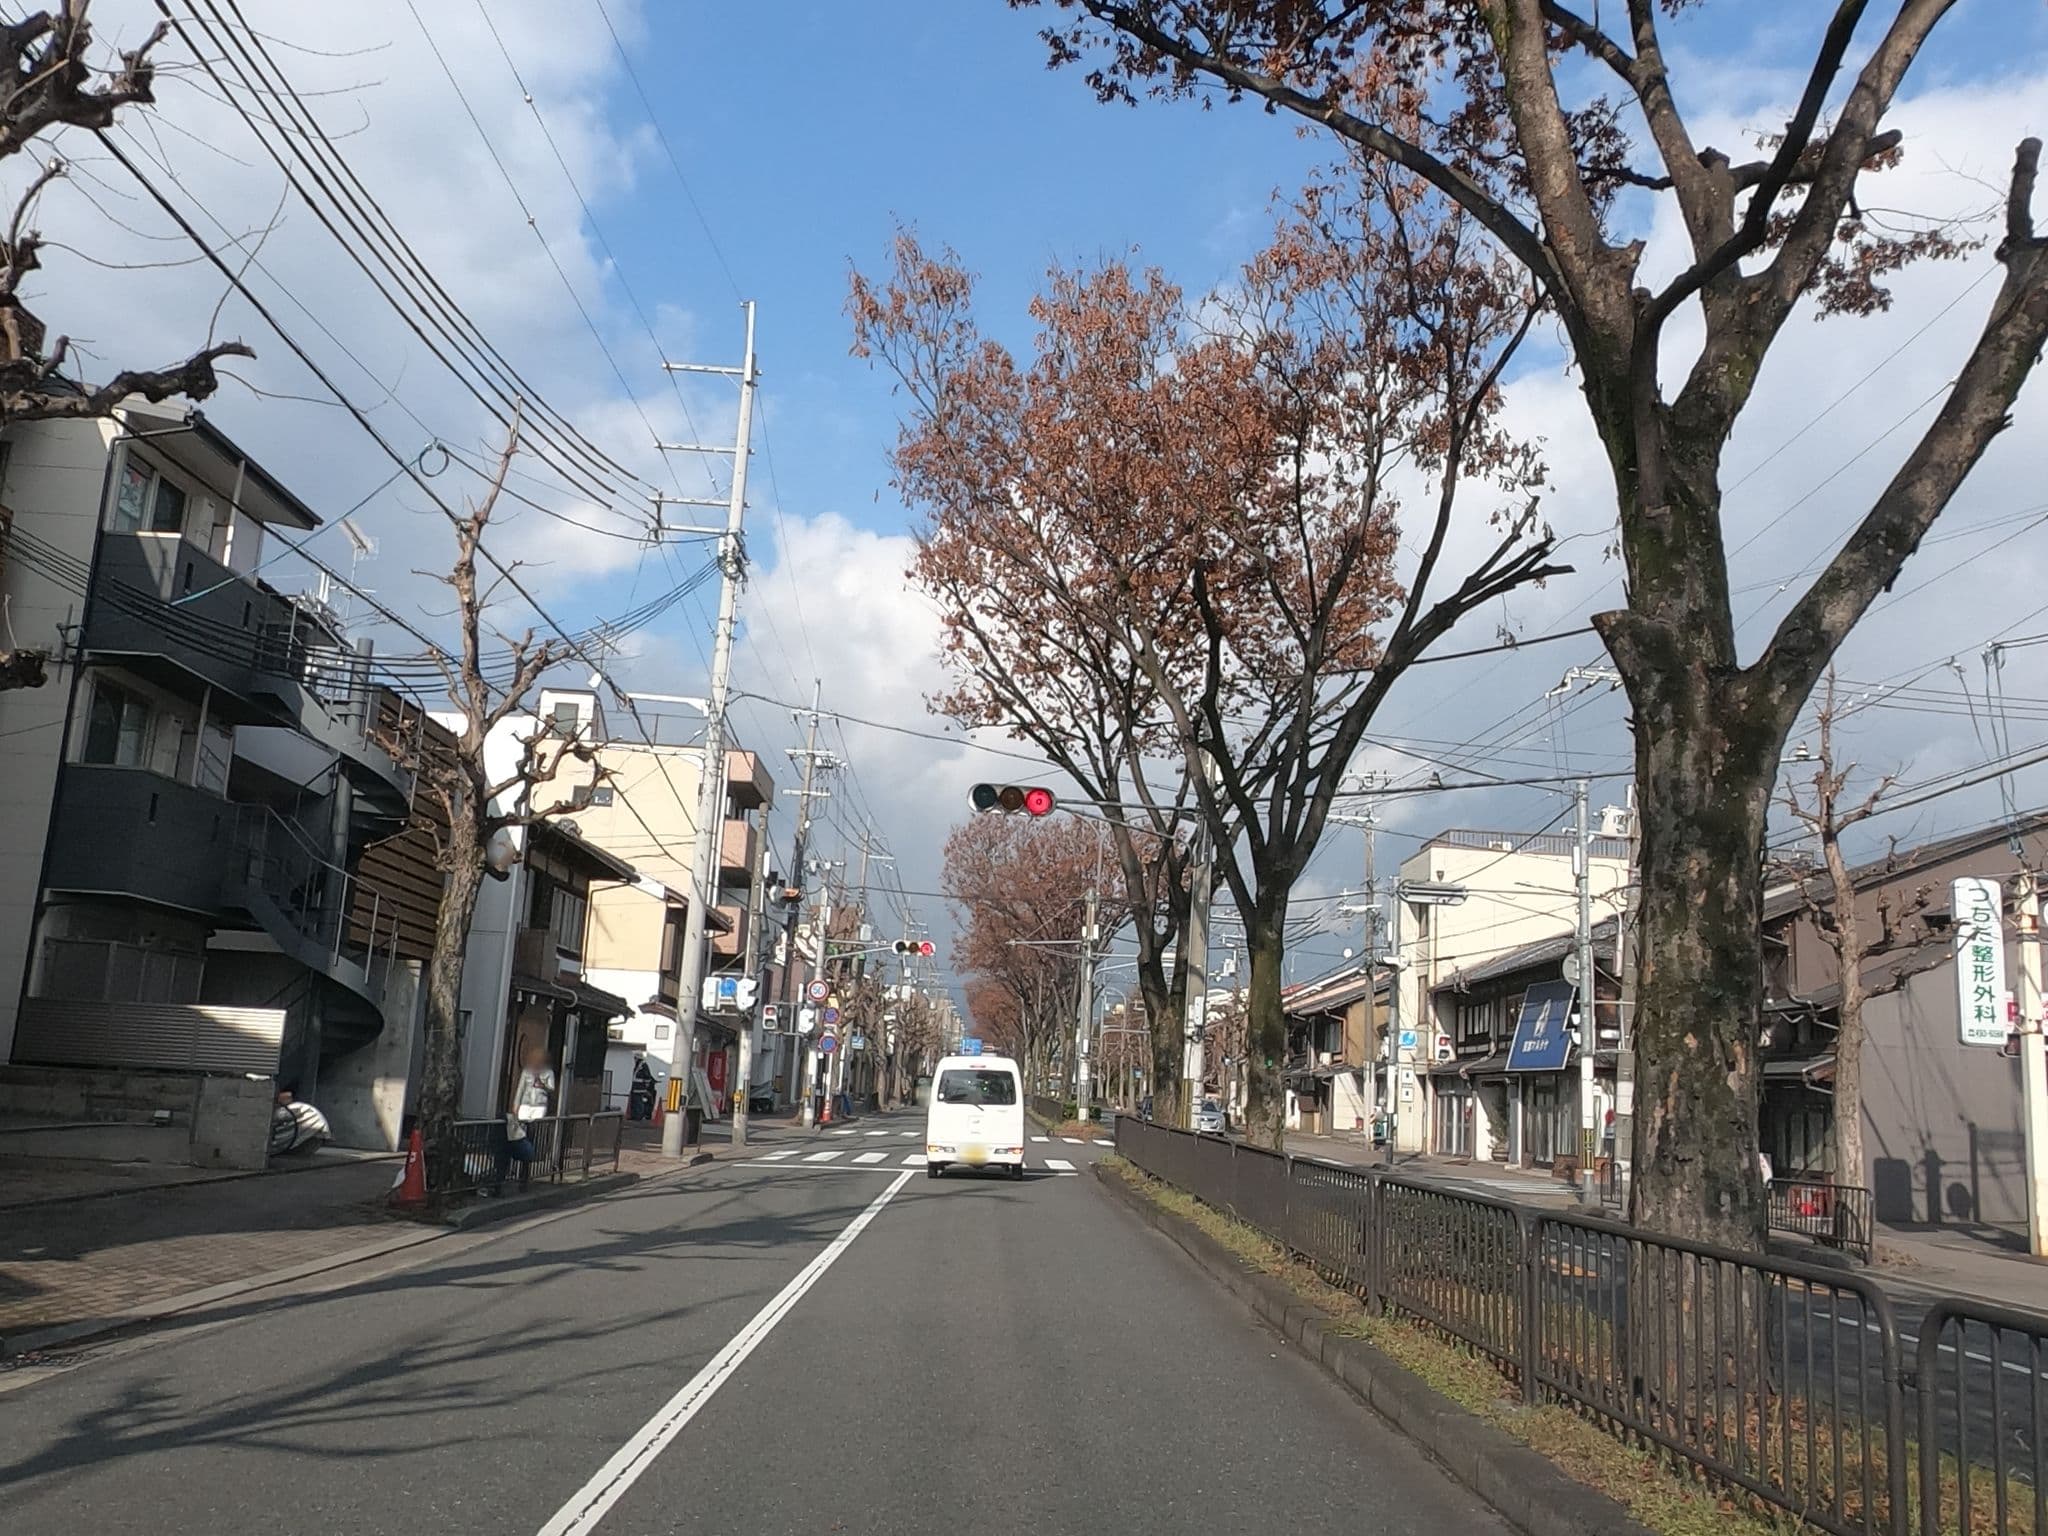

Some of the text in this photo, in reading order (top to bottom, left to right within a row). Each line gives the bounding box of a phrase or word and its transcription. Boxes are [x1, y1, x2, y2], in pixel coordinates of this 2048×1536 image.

[1968, 887, 1997, 1024] つちだ整形外科
